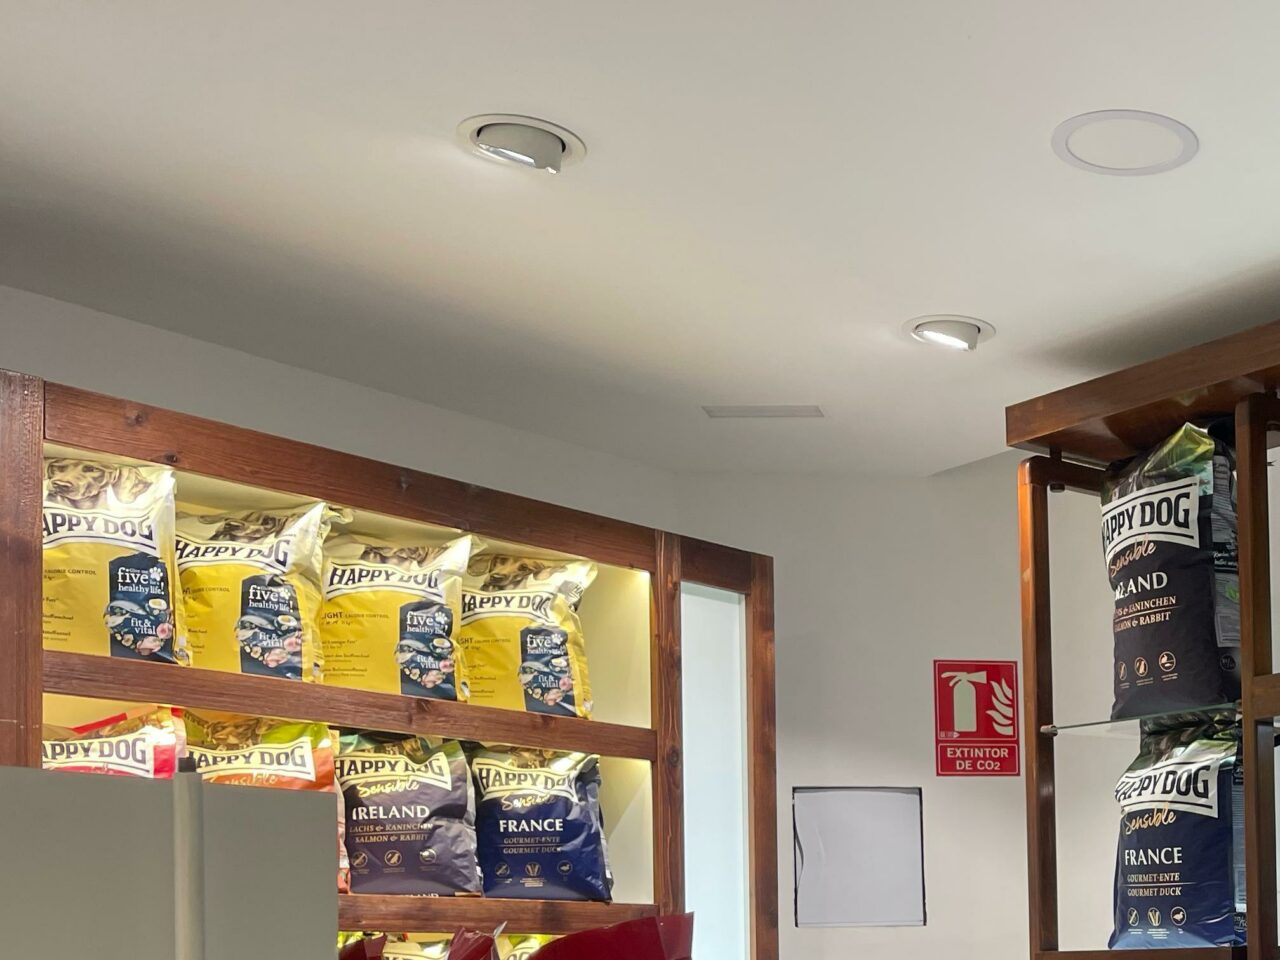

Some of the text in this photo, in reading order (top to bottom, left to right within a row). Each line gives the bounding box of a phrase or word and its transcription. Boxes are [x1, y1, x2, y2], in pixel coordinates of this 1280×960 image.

[1140, 492, 1190, 529] DOG
[43, 512, 153, 540] APPY DOG
[176, 540, 243, 560] HAPPY
[1110, 532, 1157, 578] Sensible
[118, 567, 149, 583] five
[328, 566, 396, 587] HAPPY
[118, 584, 149, 595] healthy
[249, 585, 279, 600] five
[249, 601, 279, 612] healthy
[131, 618, 143, 627] fit
[407, 611, 434, 626] five
[1139, 612, 1171, 626] RABBIT
[134, 624, 156, 635] vital
[407, 625, 434, 636] healthy
[527, 634, 551, 647] five
[420, 659, 439, 669] vital
[541, 679, 558, 688] vital
[42, 737, 147, 765] APPY DOG
[260, 746, 307, 768] DOG
[947, 747, 1009, 758] EXTINTOR
[334, 759, 401, 779] HAPPY
[956, 760, 973, 770] DE
[477, 767, 540, 790] HAPPY
[1115, 765, 1211, 801] HAPPY DOG
[356, 775, 420, 798] Sensible
[352, 805, 430, 821] IRELAND
[1125, 803, 1176, 835] Sensible
[499, 818, 564, 833] FRANCE
[400, 833, 429, 841] RABBIT
[1125, 847, 1182, 866] FRANCE
[1127, 872, 1180, 882] GOURMET-ENTE
[1127, 886, 1182, 897] GOURMET DUCK
